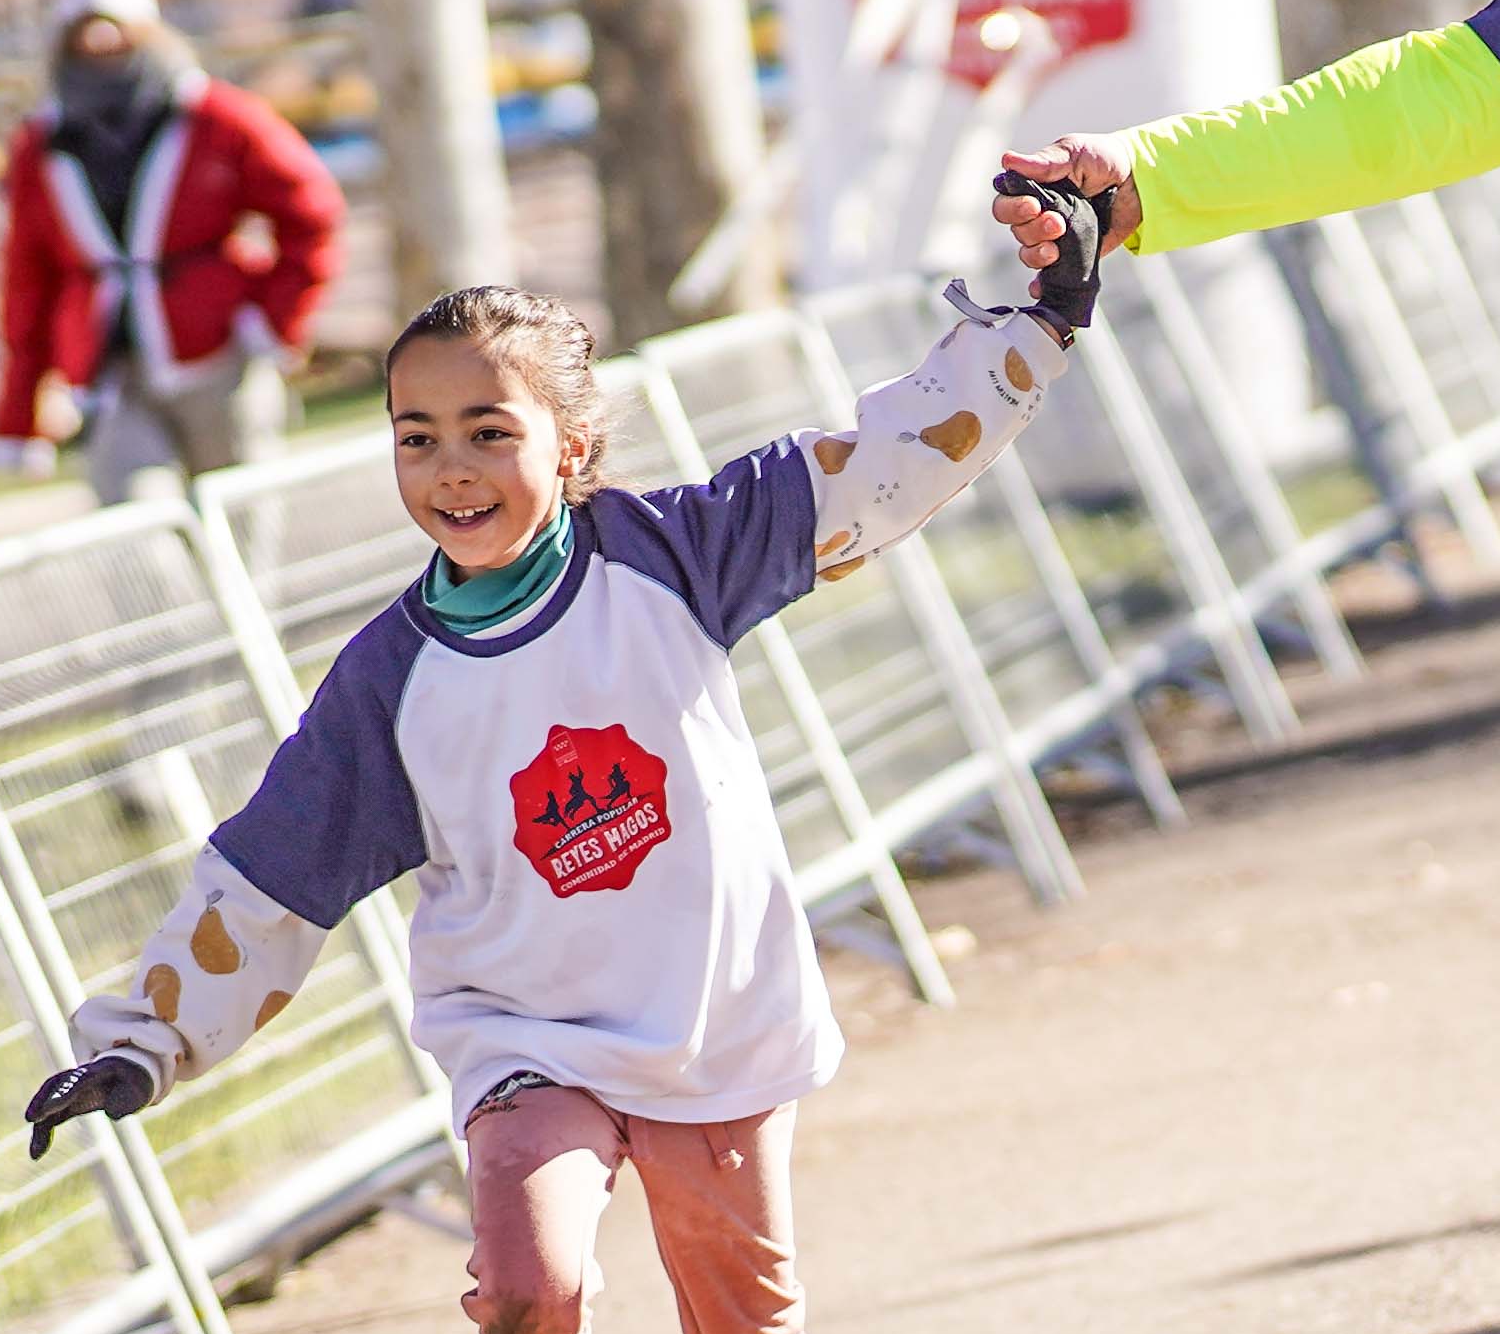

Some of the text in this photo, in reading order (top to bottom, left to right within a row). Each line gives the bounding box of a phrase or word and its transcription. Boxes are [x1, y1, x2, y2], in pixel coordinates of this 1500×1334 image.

[550, 802, 659, 880] REYES MAGOS
[555, 796, 639, 849] CARRERA POPULAR
[560, 859, 618, 892] COMUNIDAD
[628, 826, 666, 853] MADRID
